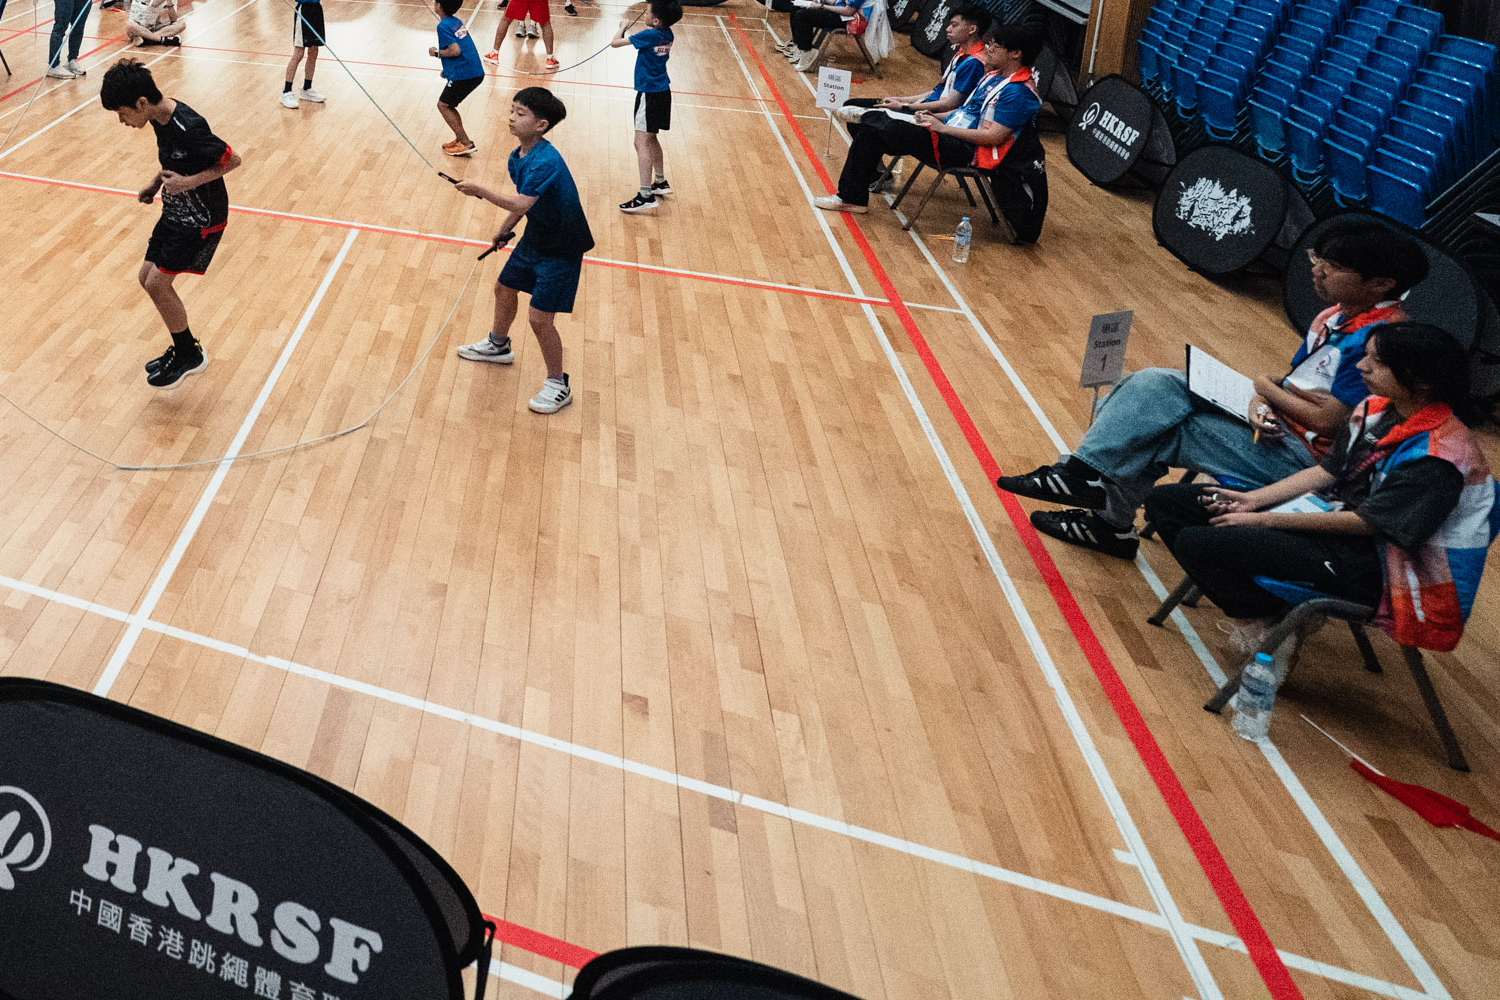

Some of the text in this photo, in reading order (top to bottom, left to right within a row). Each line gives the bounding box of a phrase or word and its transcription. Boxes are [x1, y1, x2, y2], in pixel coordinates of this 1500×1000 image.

[823, 82, 844, 90] Station
[829, 92, 836, 103] 3
[1099, 110, 1140, 146] HKRSF
[1094, 339, 1121, 349] Station
[1101, 354, 1107, 371] 1
[82, 824, 384, 985] HKRSF
